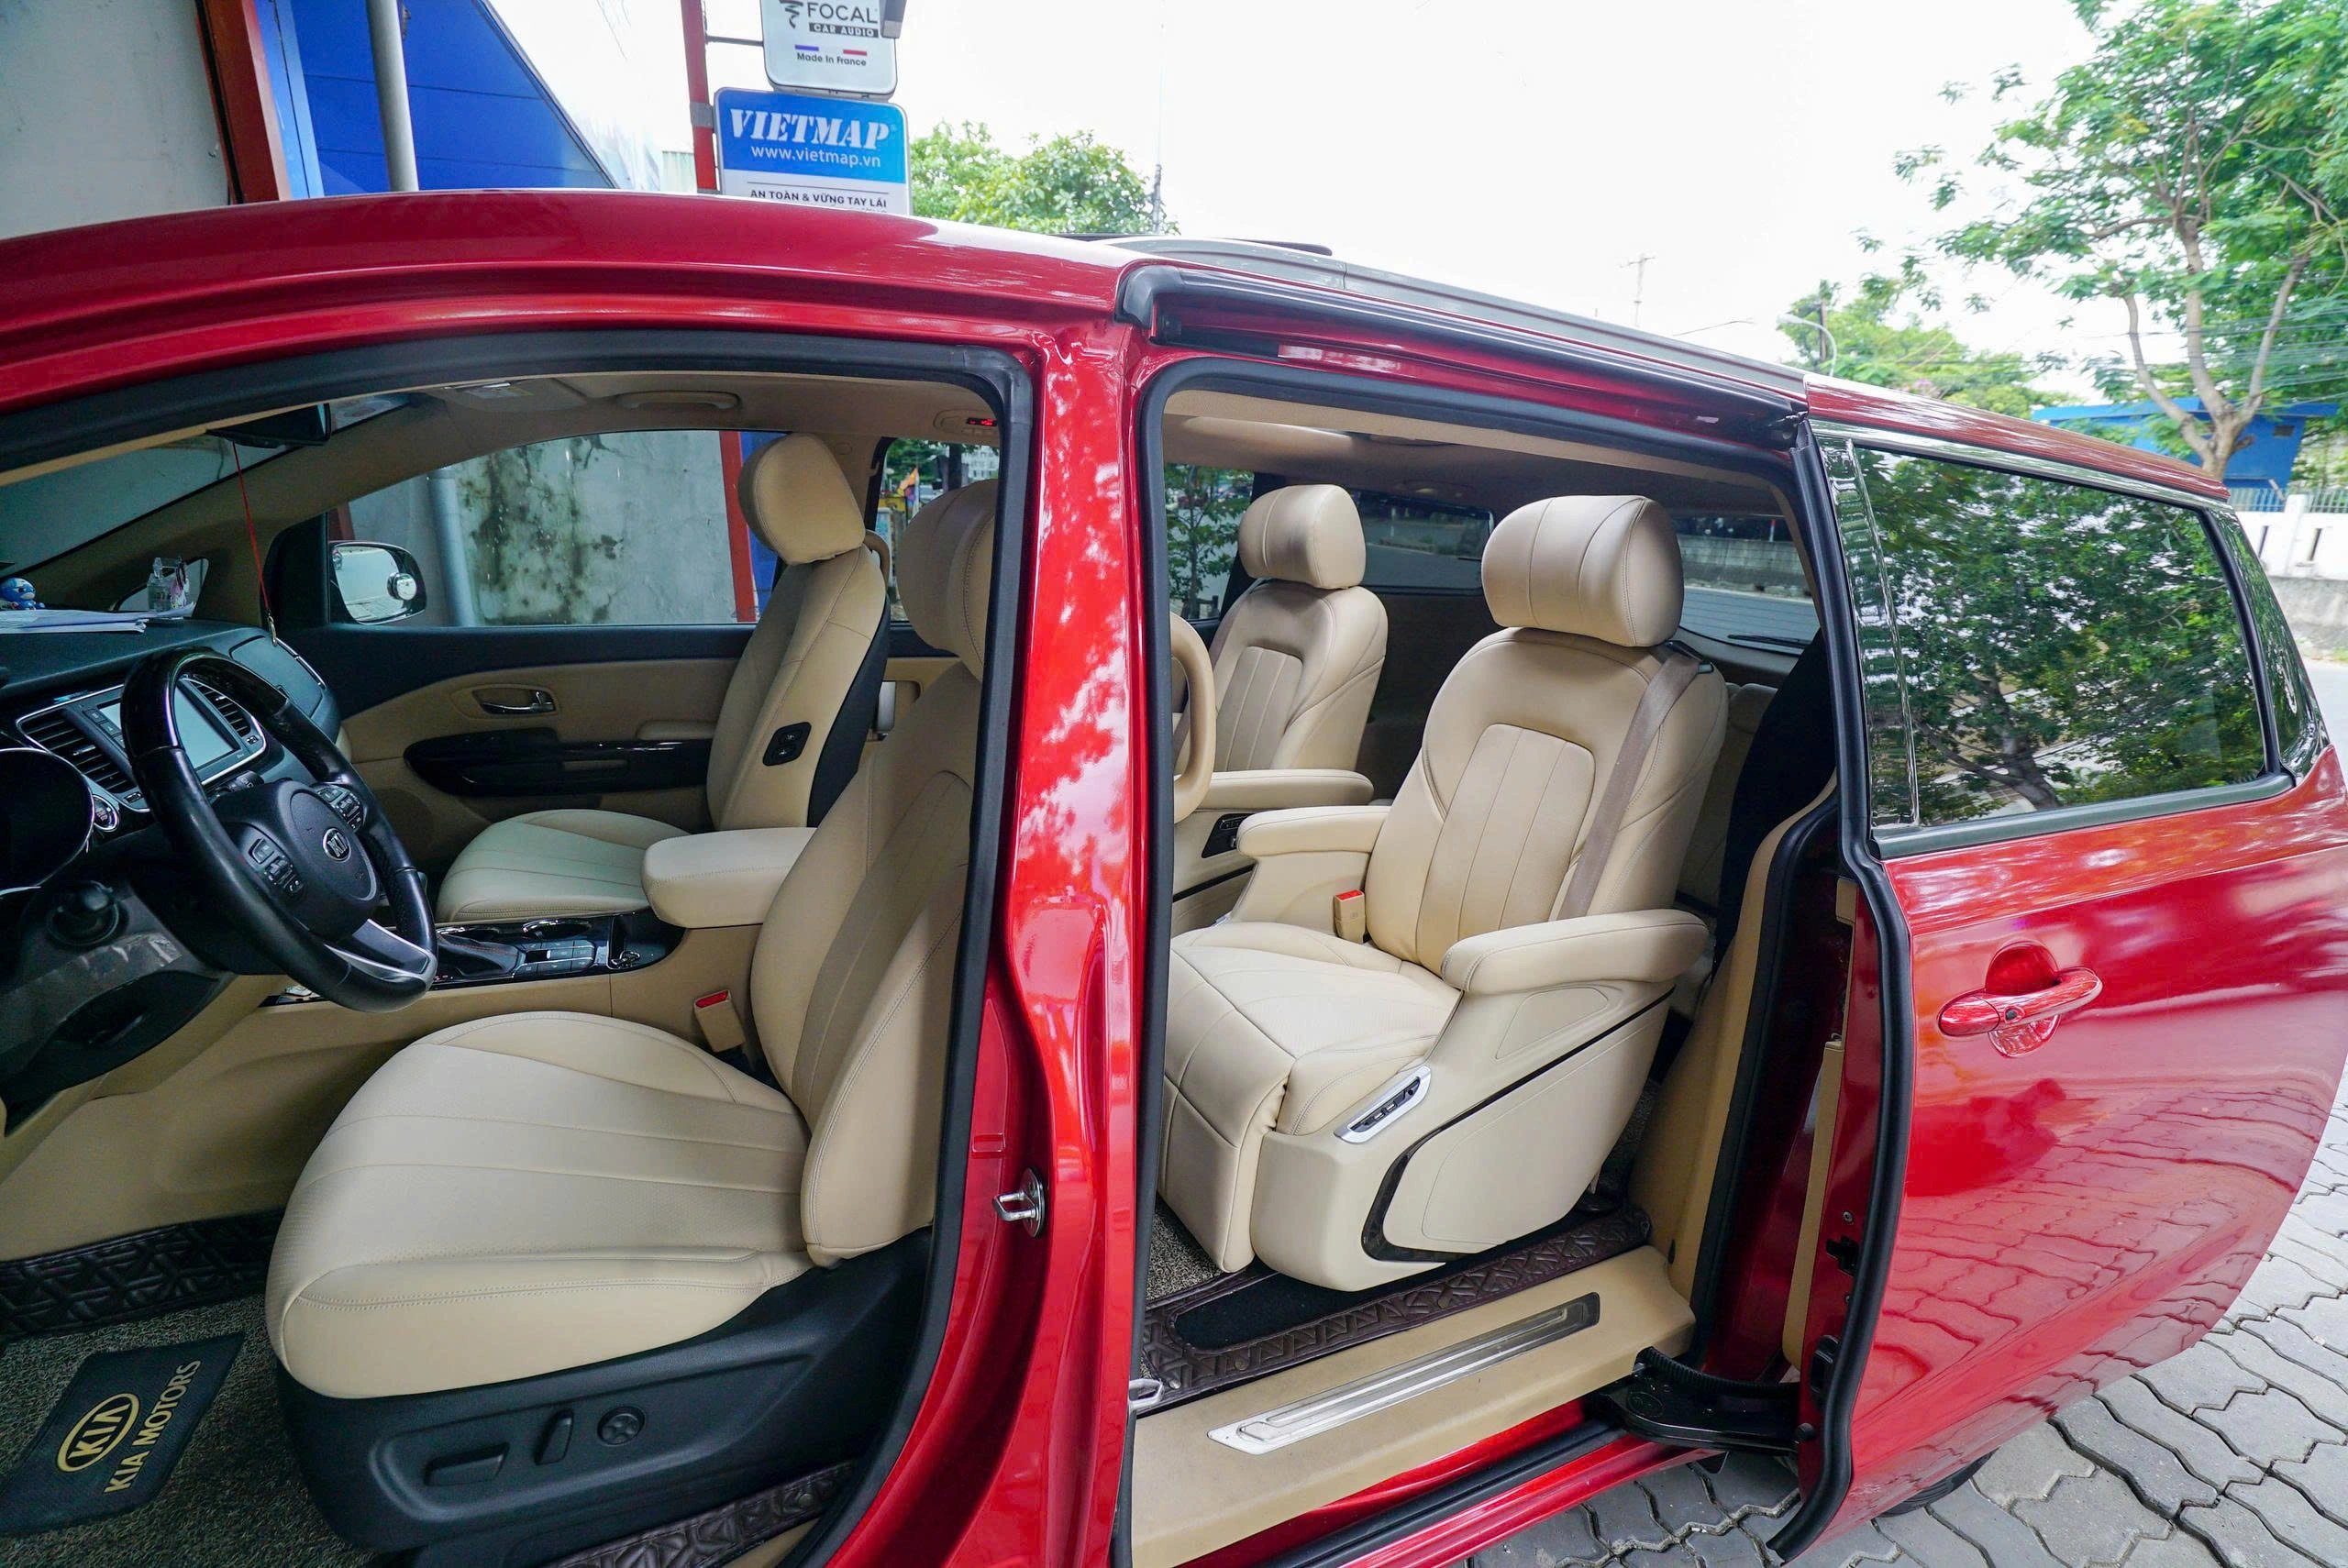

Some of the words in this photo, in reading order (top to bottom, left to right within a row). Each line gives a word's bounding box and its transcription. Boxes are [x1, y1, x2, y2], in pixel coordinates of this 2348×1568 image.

[807, 2, 878, 24] FOCAL
[814, 24, 836, 34] CAR
[840, 28, 875, 38] AUDIO
[796, 52, 823, 63] Made
[836, 57, 867, 67] France
[730, 108, 890, 150] VIETMAP
[751, 146, 881, 168] www.vietmap.vn
[750, 190, 766, 199] AN
[770, 191, 799, 202] TOÀN
[803, 193, 810, 202] &
[847, 196, 867, 206] TAY
[869, 197, 887, 207] LÁI
[104, 1451, 150, 1493] KIA
[132, 1360, 202, 1446] MOTORS
